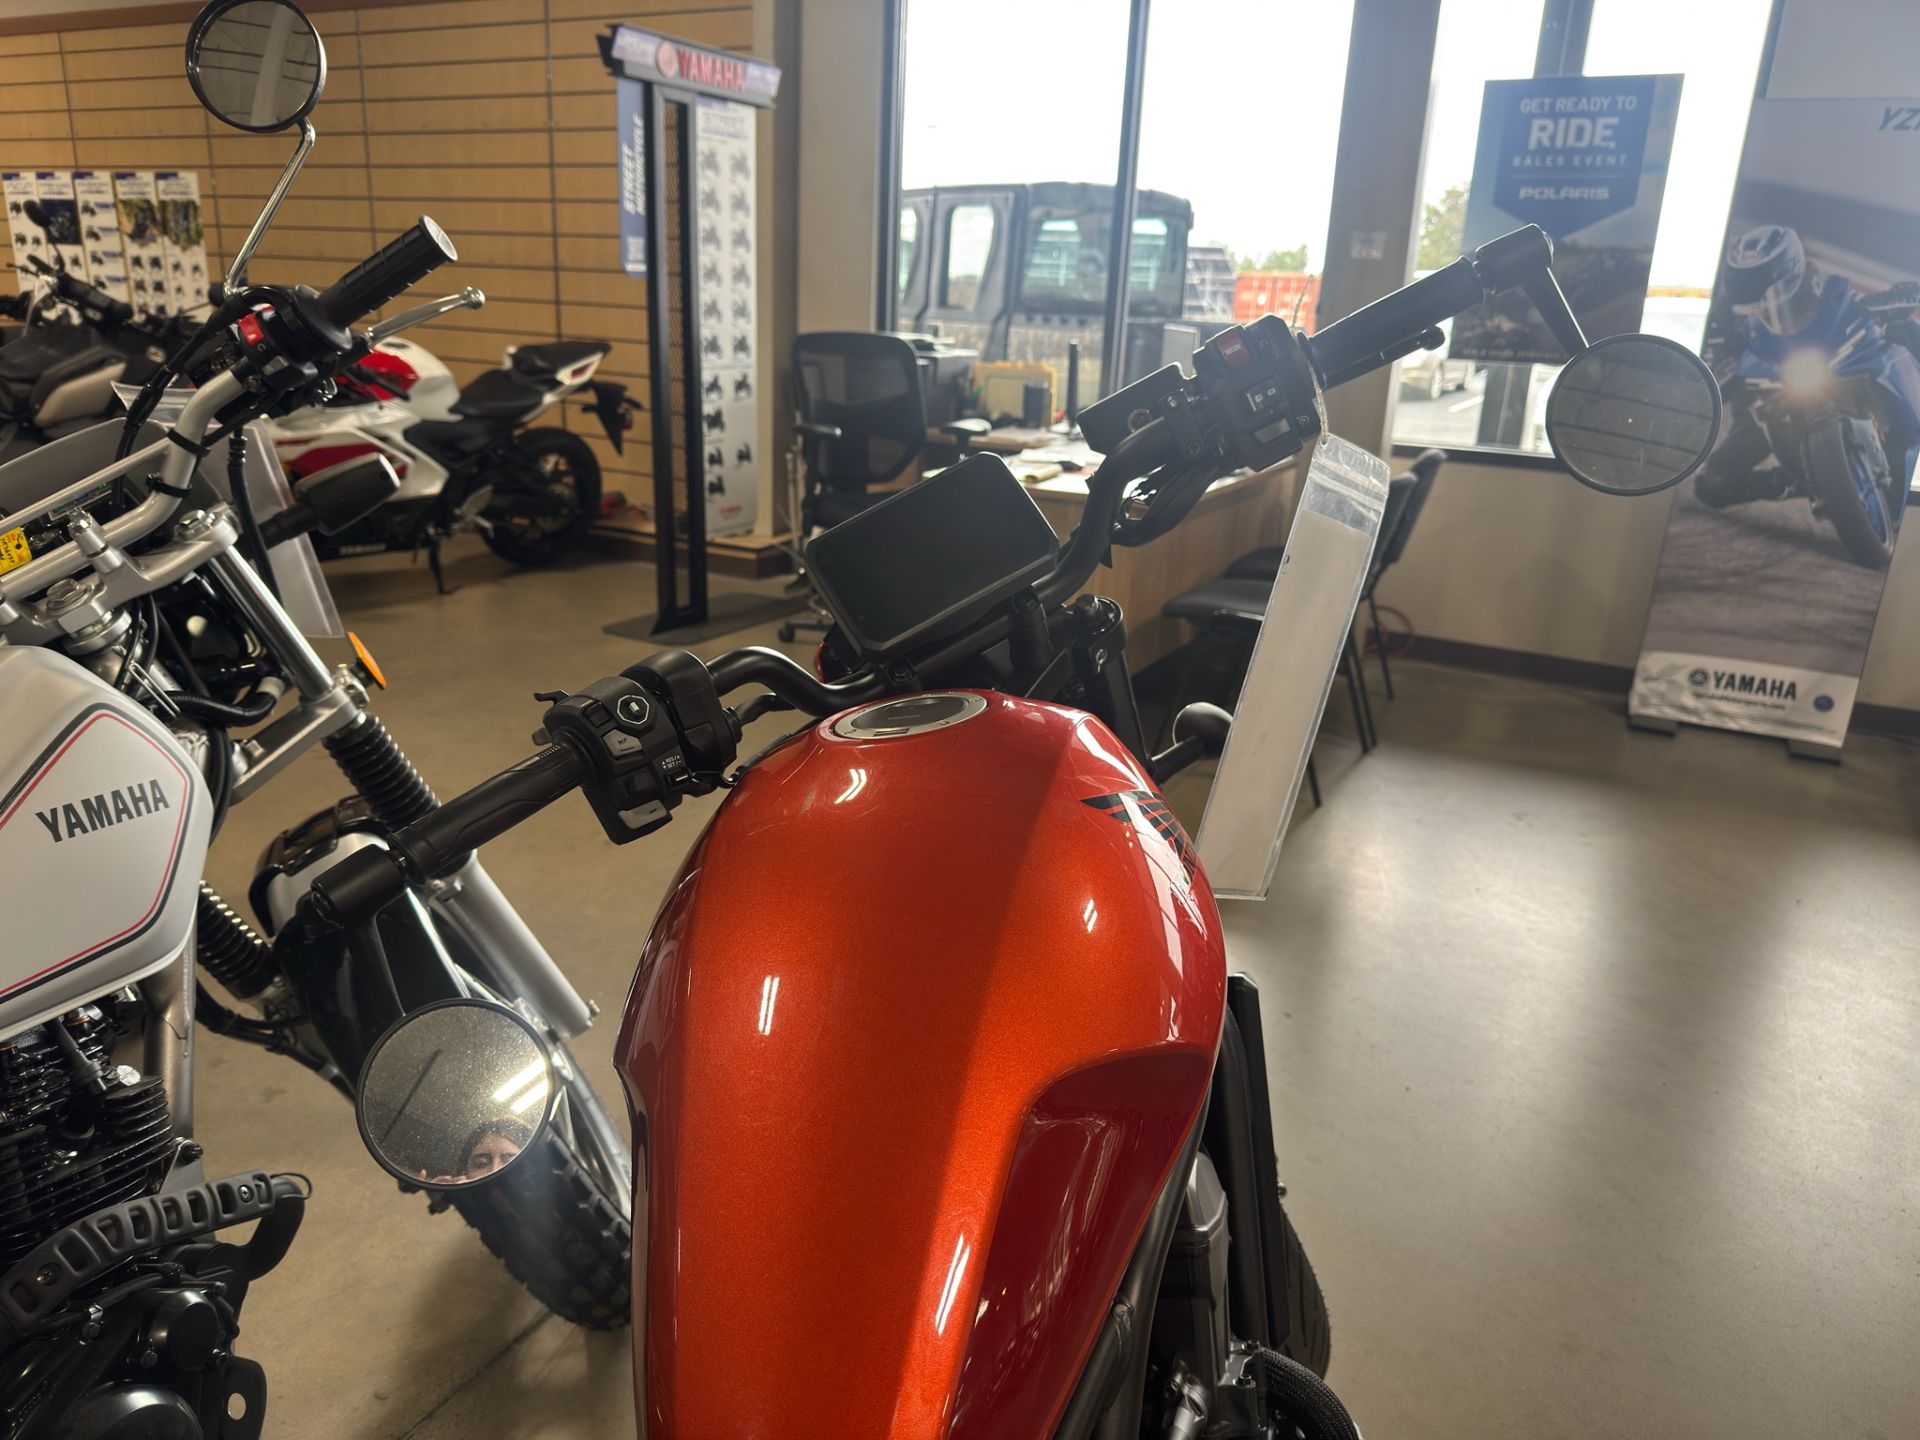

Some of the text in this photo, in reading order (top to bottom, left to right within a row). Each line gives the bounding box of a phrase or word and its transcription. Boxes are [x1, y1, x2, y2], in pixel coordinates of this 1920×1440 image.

[678, 47, 745, 93] YAMAHA
[1520, 95, 1637, 113] GET READY TO
[1528, 116, 1620, 150] RIDE
[1512, 154, 1627, 167] SALES EVENT
[1519, 187, 1610, 200] POLARIS
[1713, 671, 1797, 700] YAMAHA
[35, 779, 170, 843] YAMAHA
